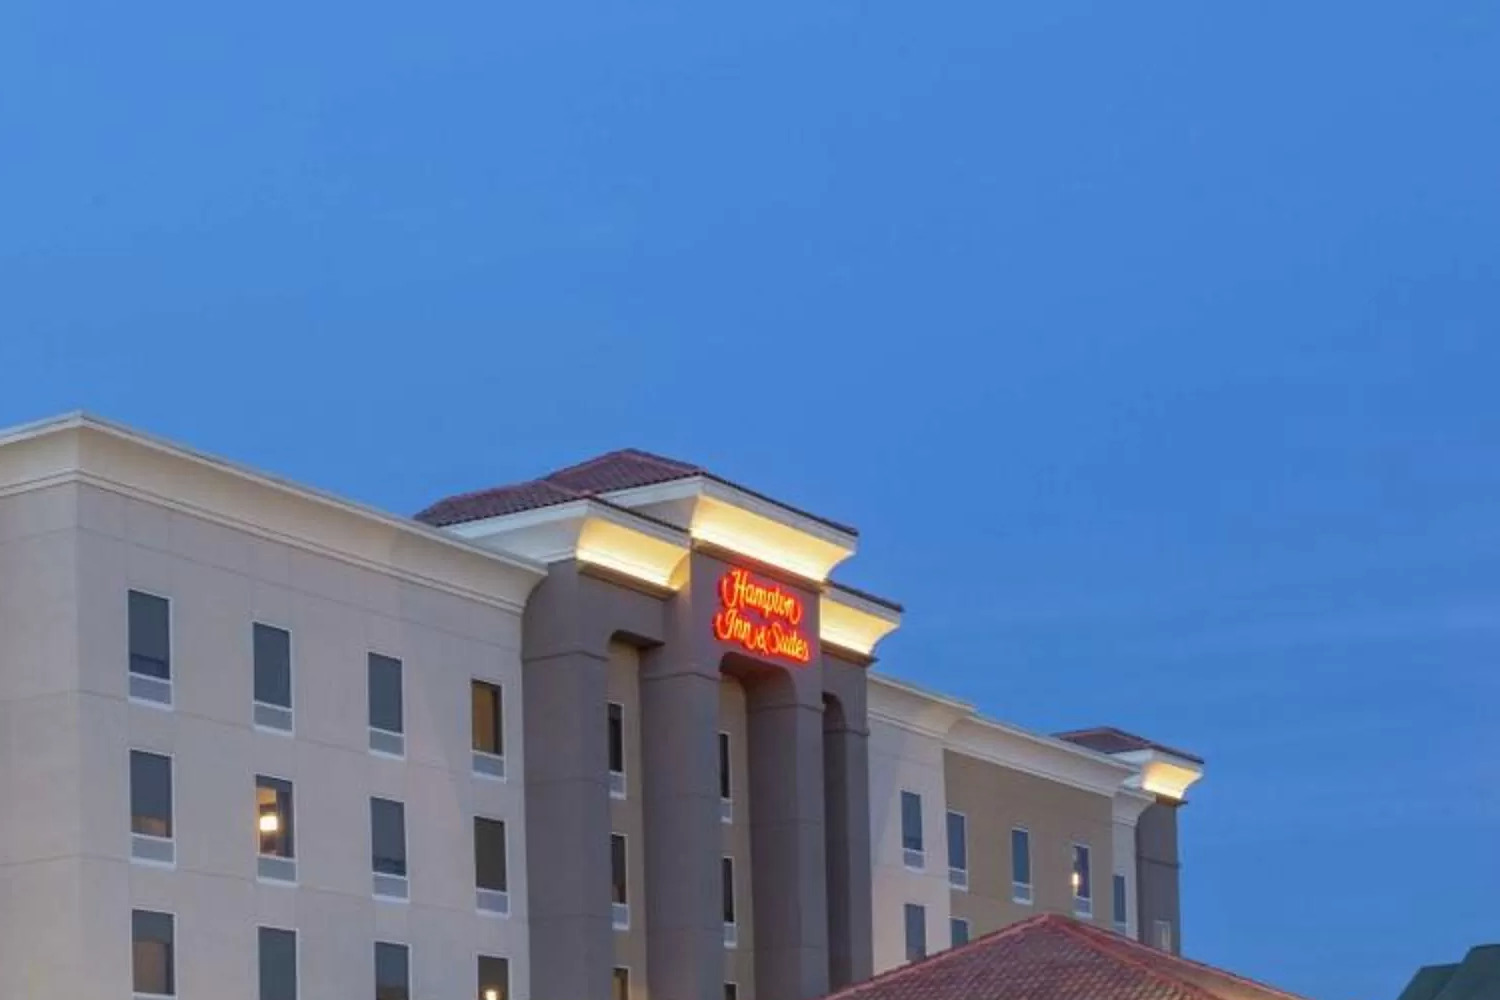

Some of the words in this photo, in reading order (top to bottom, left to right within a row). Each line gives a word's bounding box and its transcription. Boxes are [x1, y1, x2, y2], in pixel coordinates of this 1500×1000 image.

[721, 569, 802, 625] Hampton
[714, 607, 757, 650] Inn
[764, 621, 810, 662] Suites
